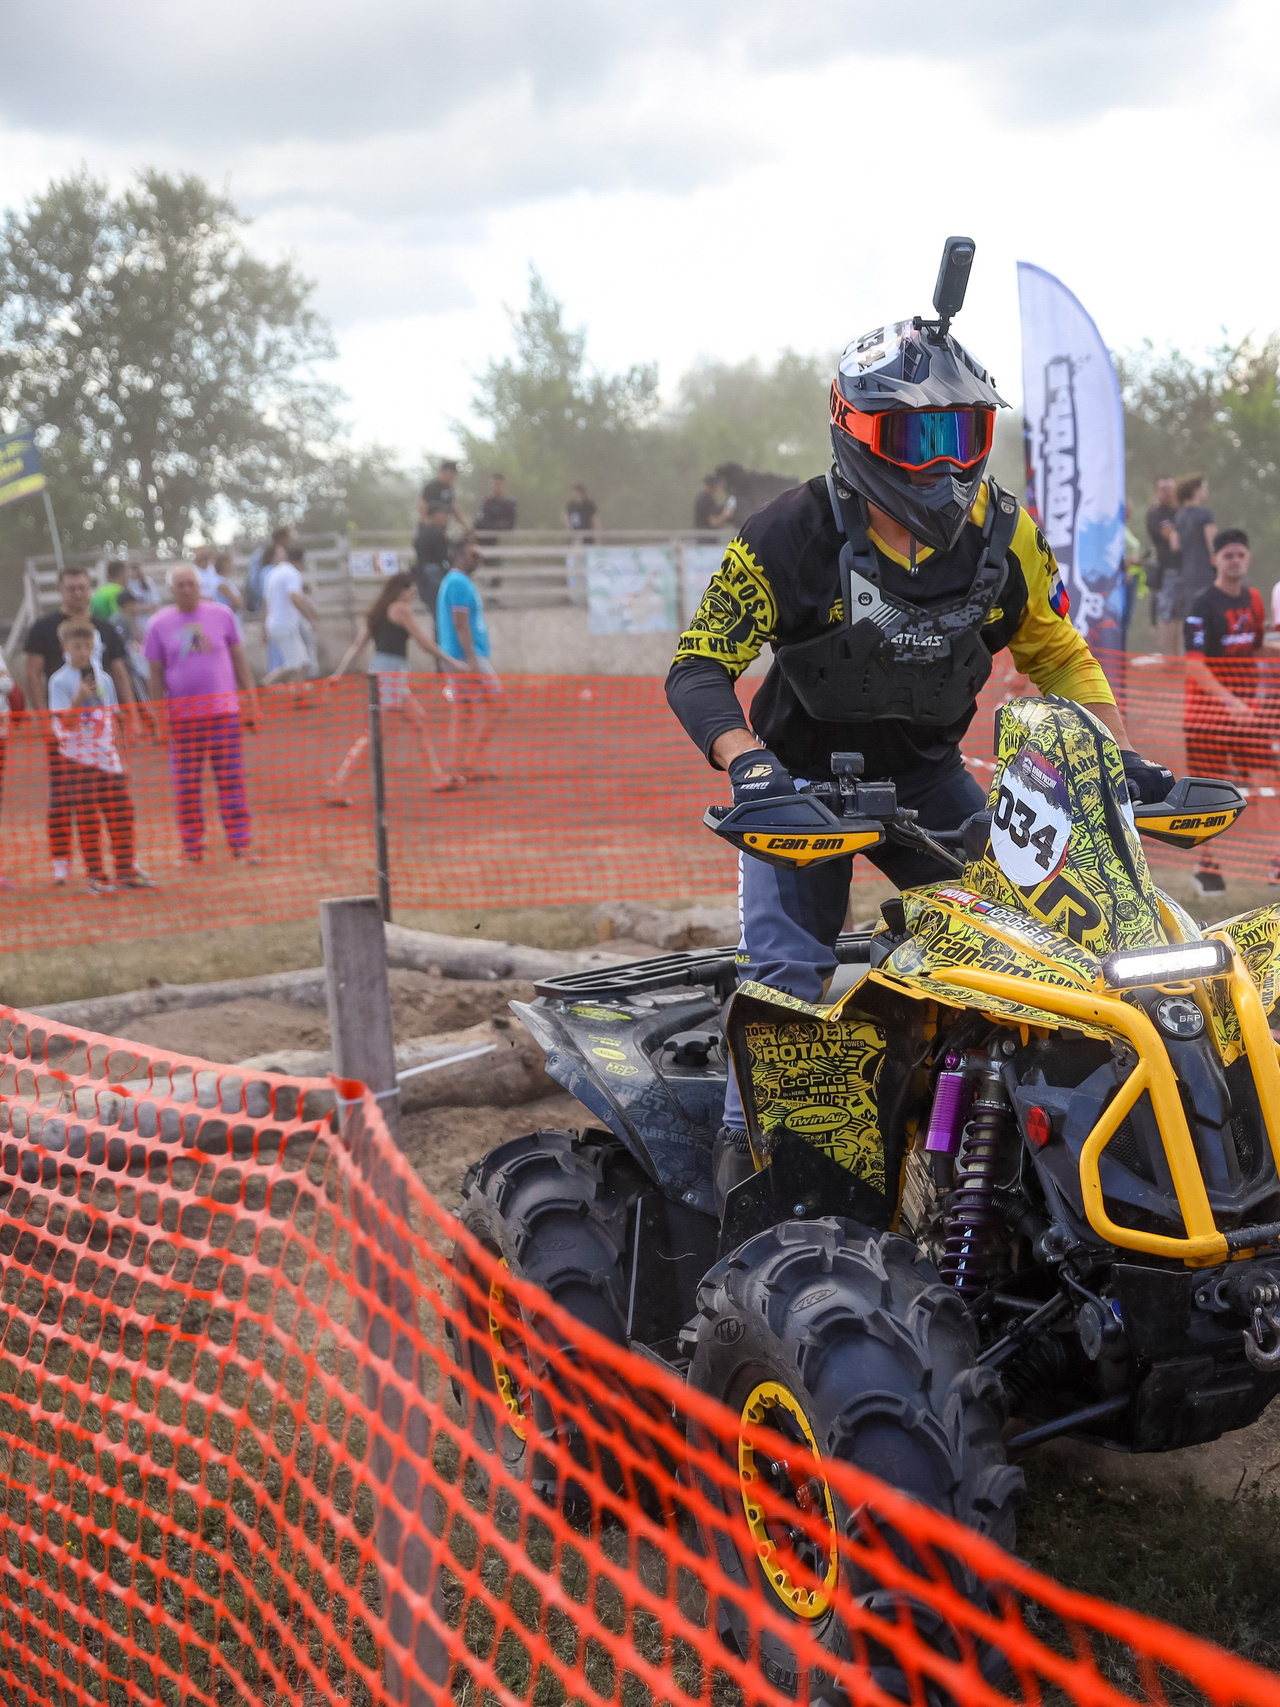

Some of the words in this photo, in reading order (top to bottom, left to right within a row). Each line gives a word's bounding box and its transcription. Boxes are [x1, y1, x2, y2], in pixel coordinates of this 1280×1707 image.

[891, 632, 944, 647] ATLAS
[994, 785, 1057, 871] 034
[936, 887, 978, 905] MOTUL
[1179, 1014, 1201, 1023] BRP
[763, 1041, 844, 1063] ROTAX
[843, 1040, 865, 1048] POWER
[780, 1073, 846, 1088] GoPro
[790, 1114, 826, 1128] Twin
[823, 1112, 848, 1123] Air
